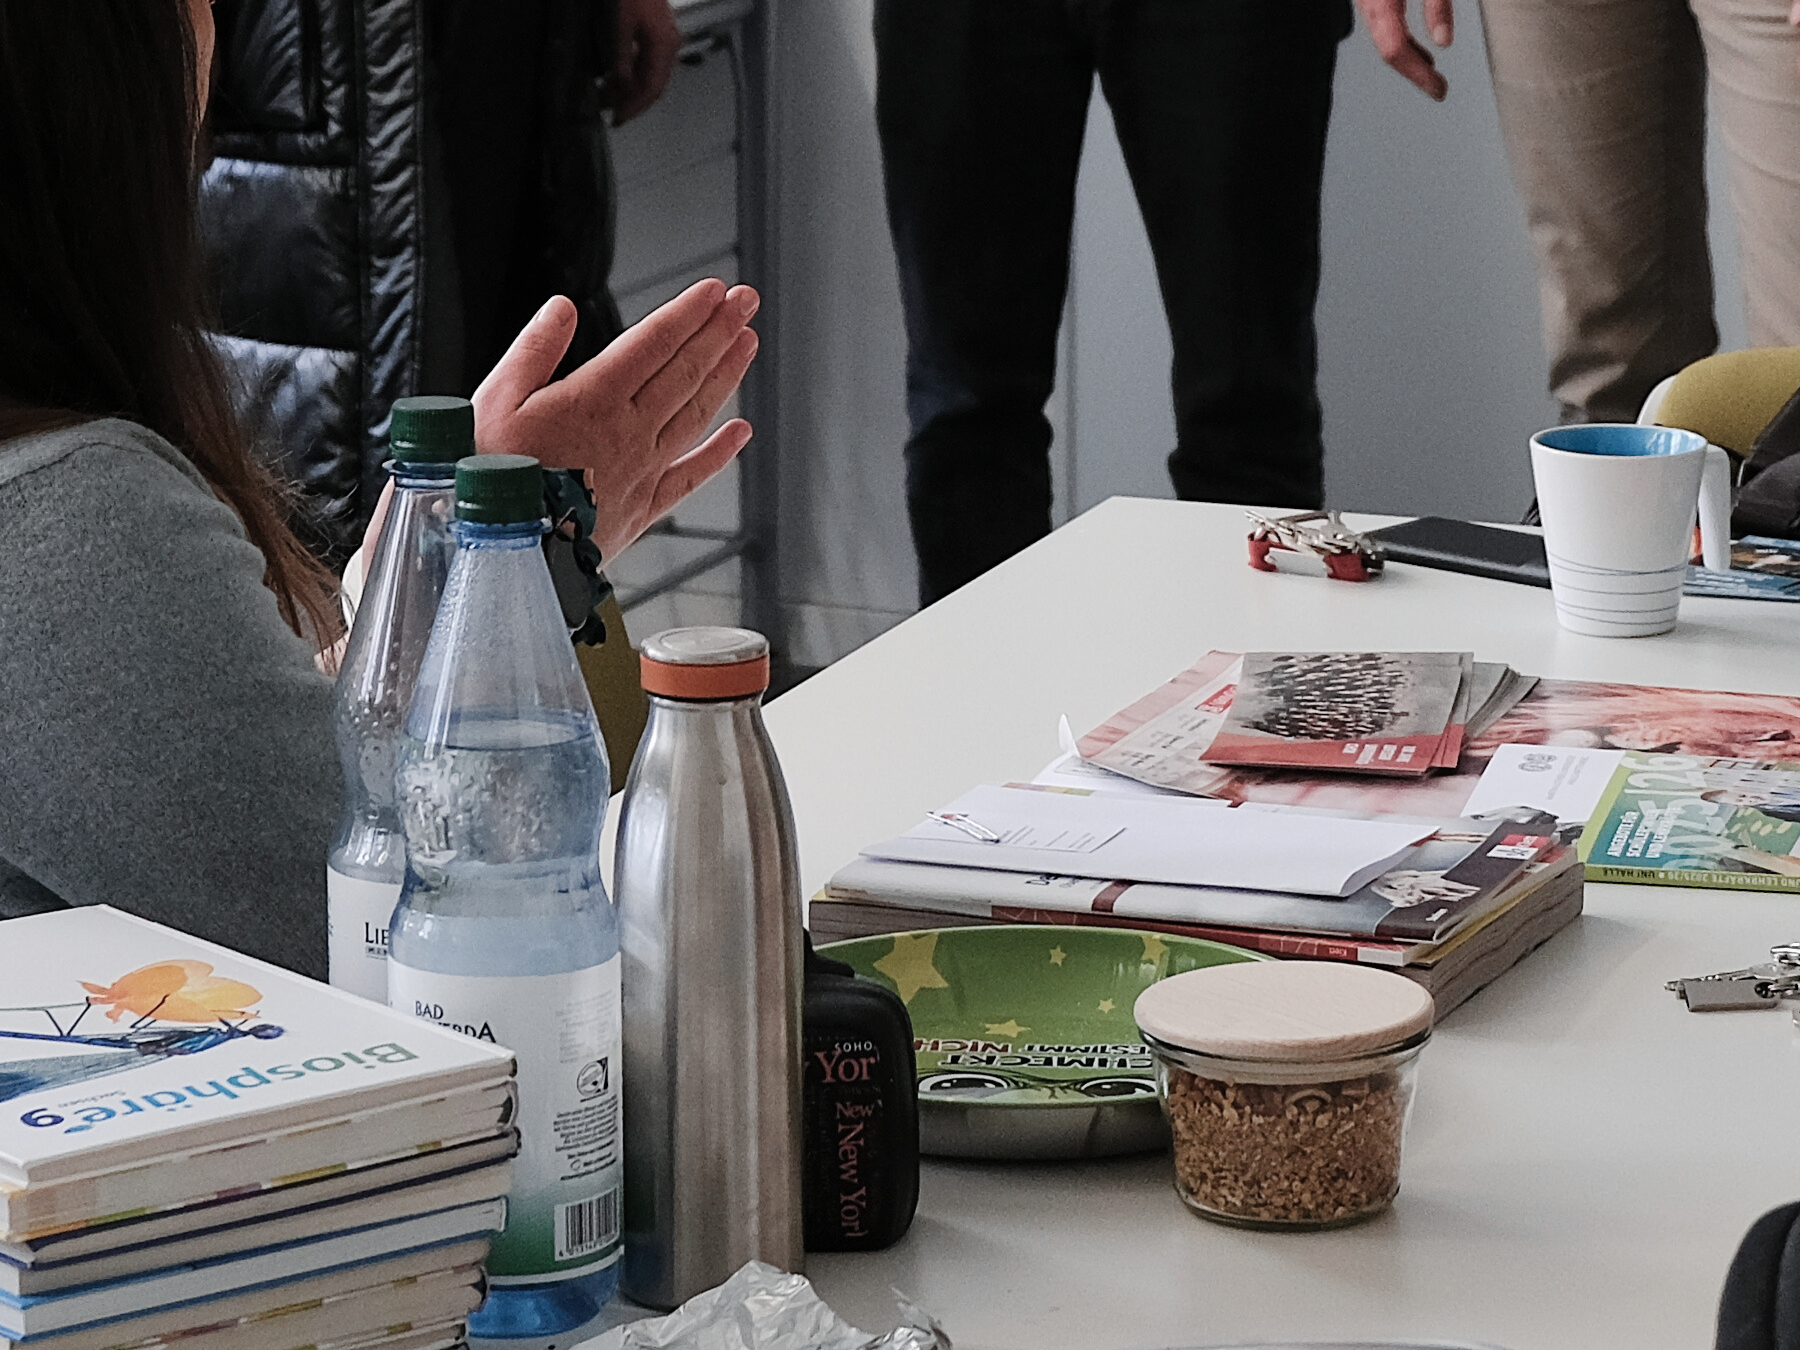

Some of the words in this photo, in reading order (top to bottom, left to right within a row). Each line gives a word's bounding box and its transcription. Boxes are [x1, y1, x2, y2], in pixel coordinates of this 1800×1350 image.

[415, 1000, 444, 1020] BAD
[834, 1040, 873, 1053] SOHO
[1018, 1043, 1153, 1056] ESTIMMT
[938, 1054, 1153, 1069] CHMECKT
[74, 1042, 420, 1125] Biosphäre
[19, 1107, 64, 1129] 9
